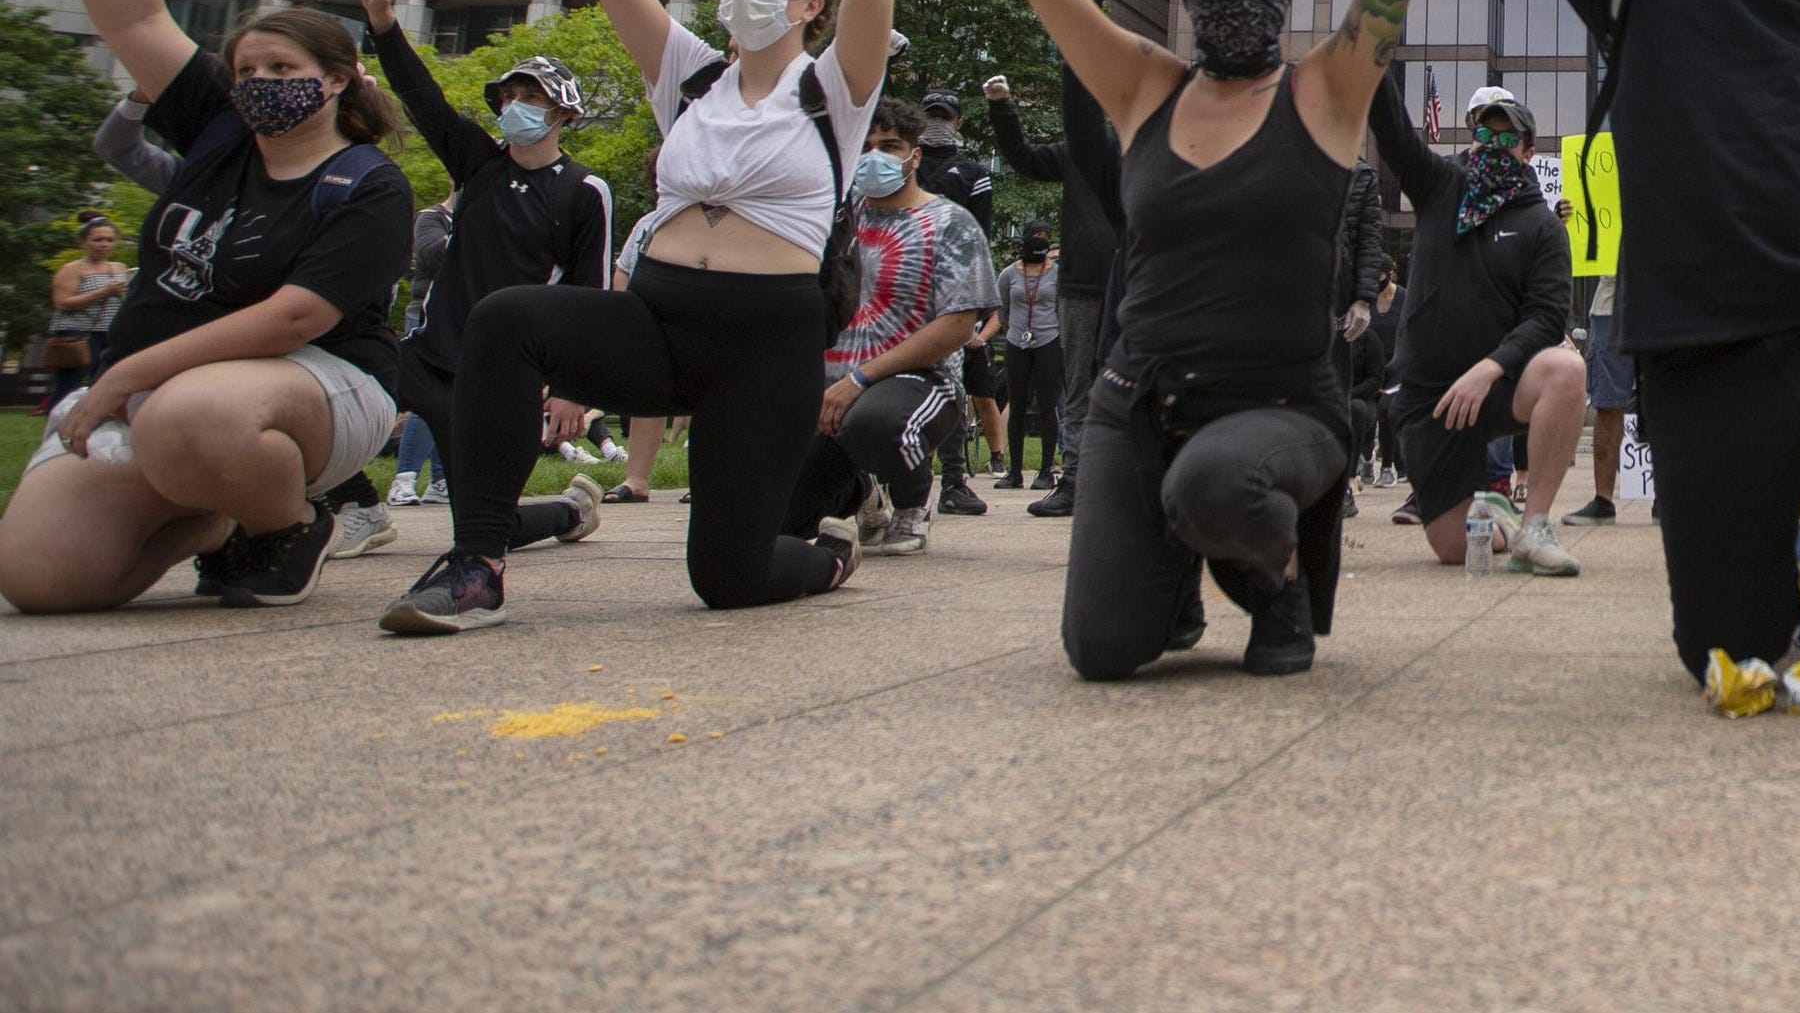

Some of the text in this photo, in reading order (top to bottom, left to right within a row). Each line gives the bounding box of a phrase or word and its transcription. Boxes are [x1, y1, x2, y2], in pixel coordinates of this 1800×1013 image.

[1536, 159, 1559, 177] the
[1575, 151, 1614, 179] NO
[1575, 207, 1611, 234] NO
